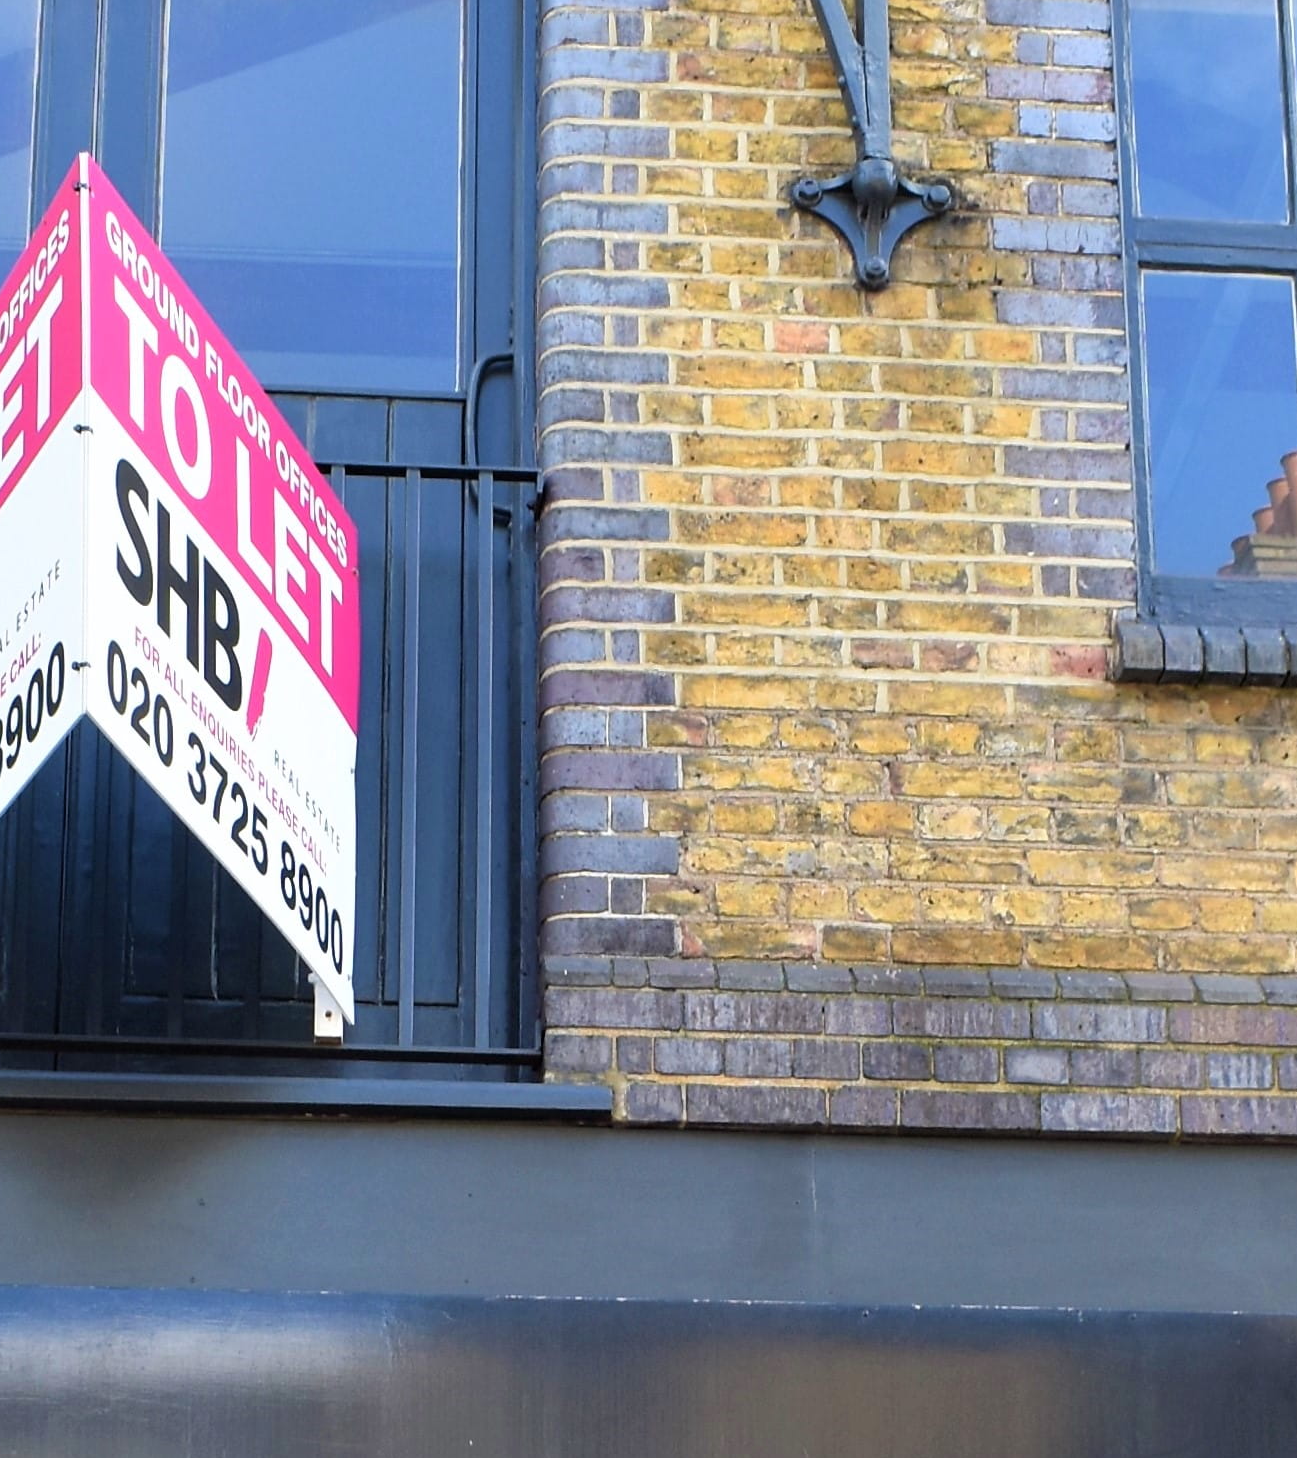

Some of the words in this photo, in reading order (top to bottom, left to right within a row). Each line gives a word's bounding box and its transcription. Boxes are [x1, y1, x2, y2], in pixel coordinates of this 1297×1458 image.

[105, 210, 200, 359] GROUND
[205, 340, 271, 458] FLOOR
[275, 439, 348, 568] OFFICES
[113, 275, 212, 501] TO
[236, 436, 343, 679] LET
[9, 632, 42, 684] CALL:
[16, 558, 62, 633] ESTATE
[116, 458, 242, 712] SHB
[106, 639, 175, 768] 020
[187, 731, 269, 876] 3725
[280, 840, 344, 976] 8900
[134, 625, 161, 674] FOR
[164, 662, 188, 705] ALL
[191, 691, 255, 783] ENQUIRIES
[258, 770, 300, 838] PLEASE
[300, 824, 328, 878] CALL:
[273, 748, 301, 797] REAL
[305, 790, 341, 855] ESTATE
